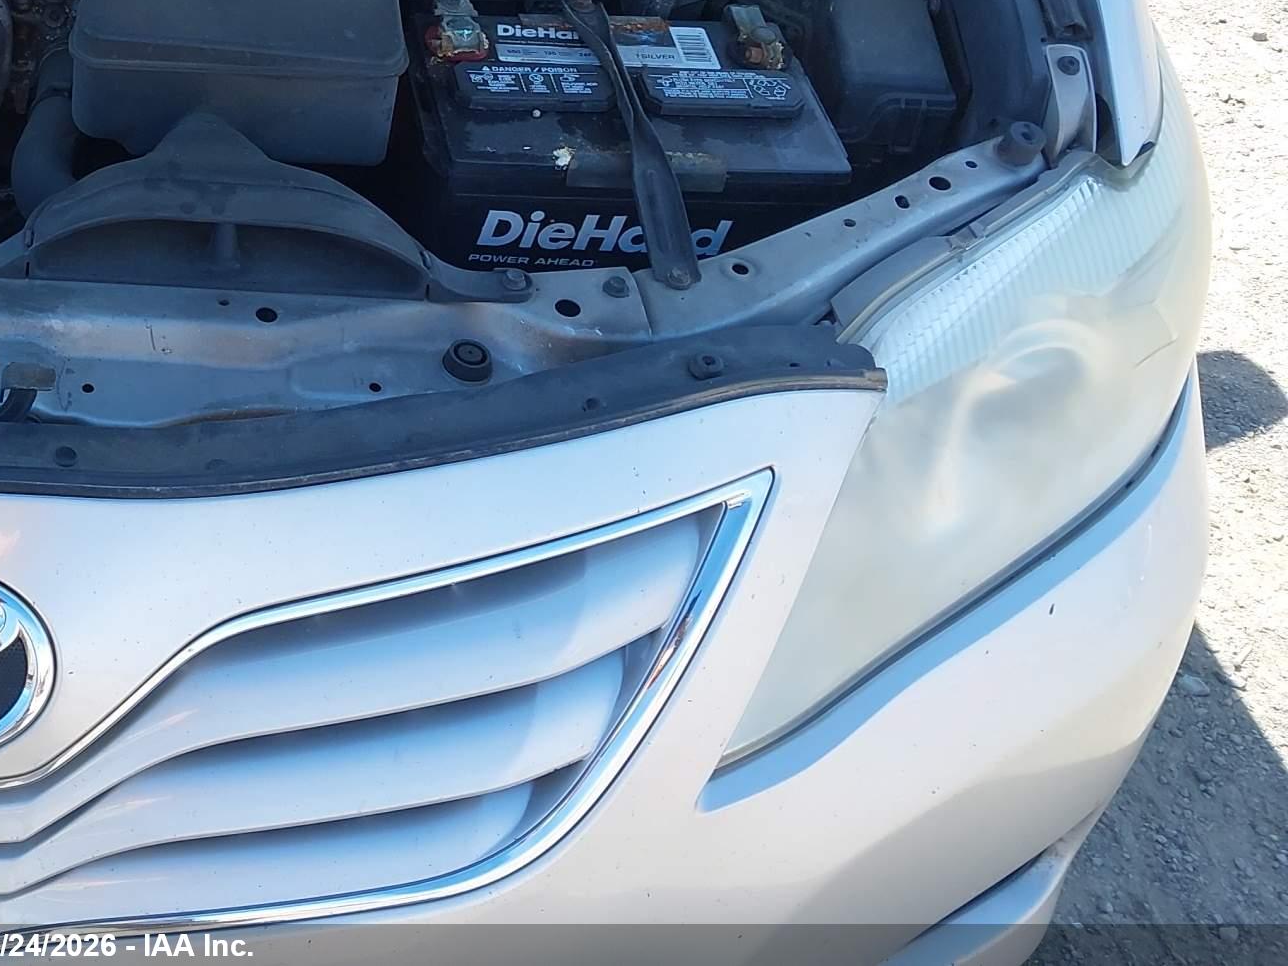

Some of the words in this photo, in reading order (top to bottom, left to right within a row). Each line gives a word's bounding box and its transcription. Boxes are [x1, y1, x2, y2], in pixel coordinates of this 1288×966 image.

[497, 24, 580, 40] DieHa
[476, 209, 734, 256] DieHad
[468, 253, 530, 265] POWER
[534, 257, 594, 267] AHEAD
